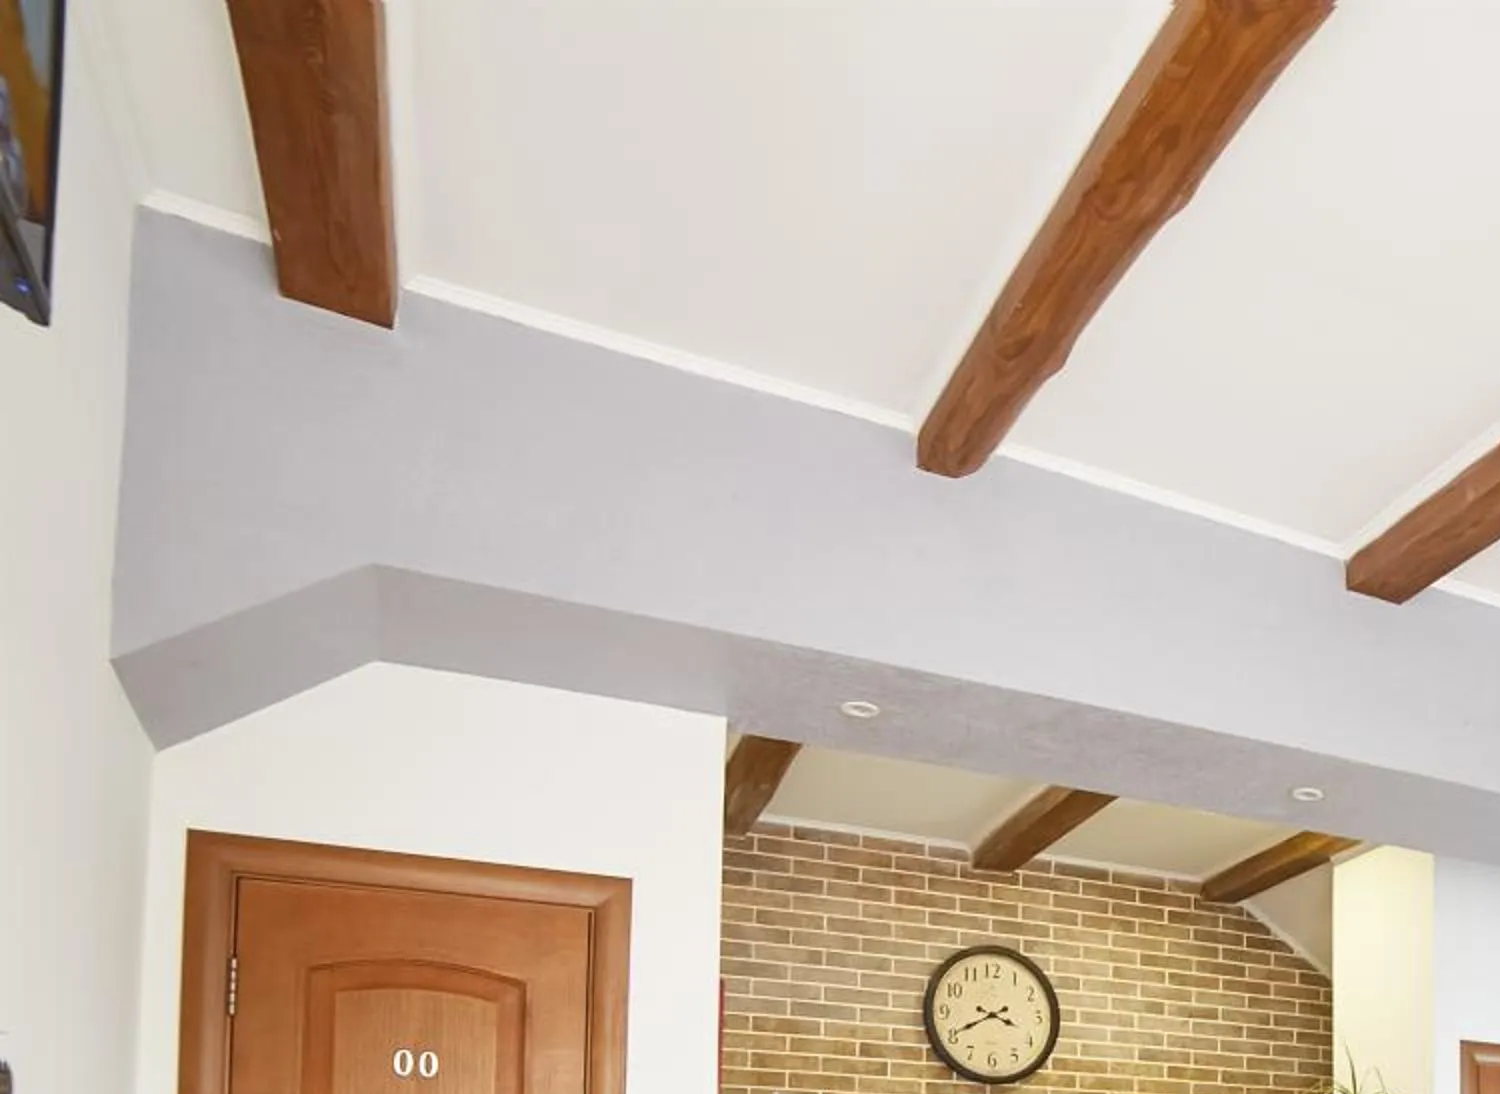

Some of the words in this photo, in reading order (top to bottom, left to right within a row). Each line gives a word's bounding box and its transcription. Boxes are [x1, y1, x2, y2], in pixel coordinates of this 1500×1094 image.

[964, 967, 977, 982] 11
[984, 963, 1001, 979] 12
[947, 983, 963, 998] 10
[1027, 987, 1036, 1002] 2
[939, 1003, 950, 1020] 9
[1035, 1010, 1043, 1025] 3
[966, 1045, 975, 1061] 7
[987, 1051, 998, 1069] 6
[1010, 1048, 1019, 1063] 5
[393, 1049, 439, 1078] 00
